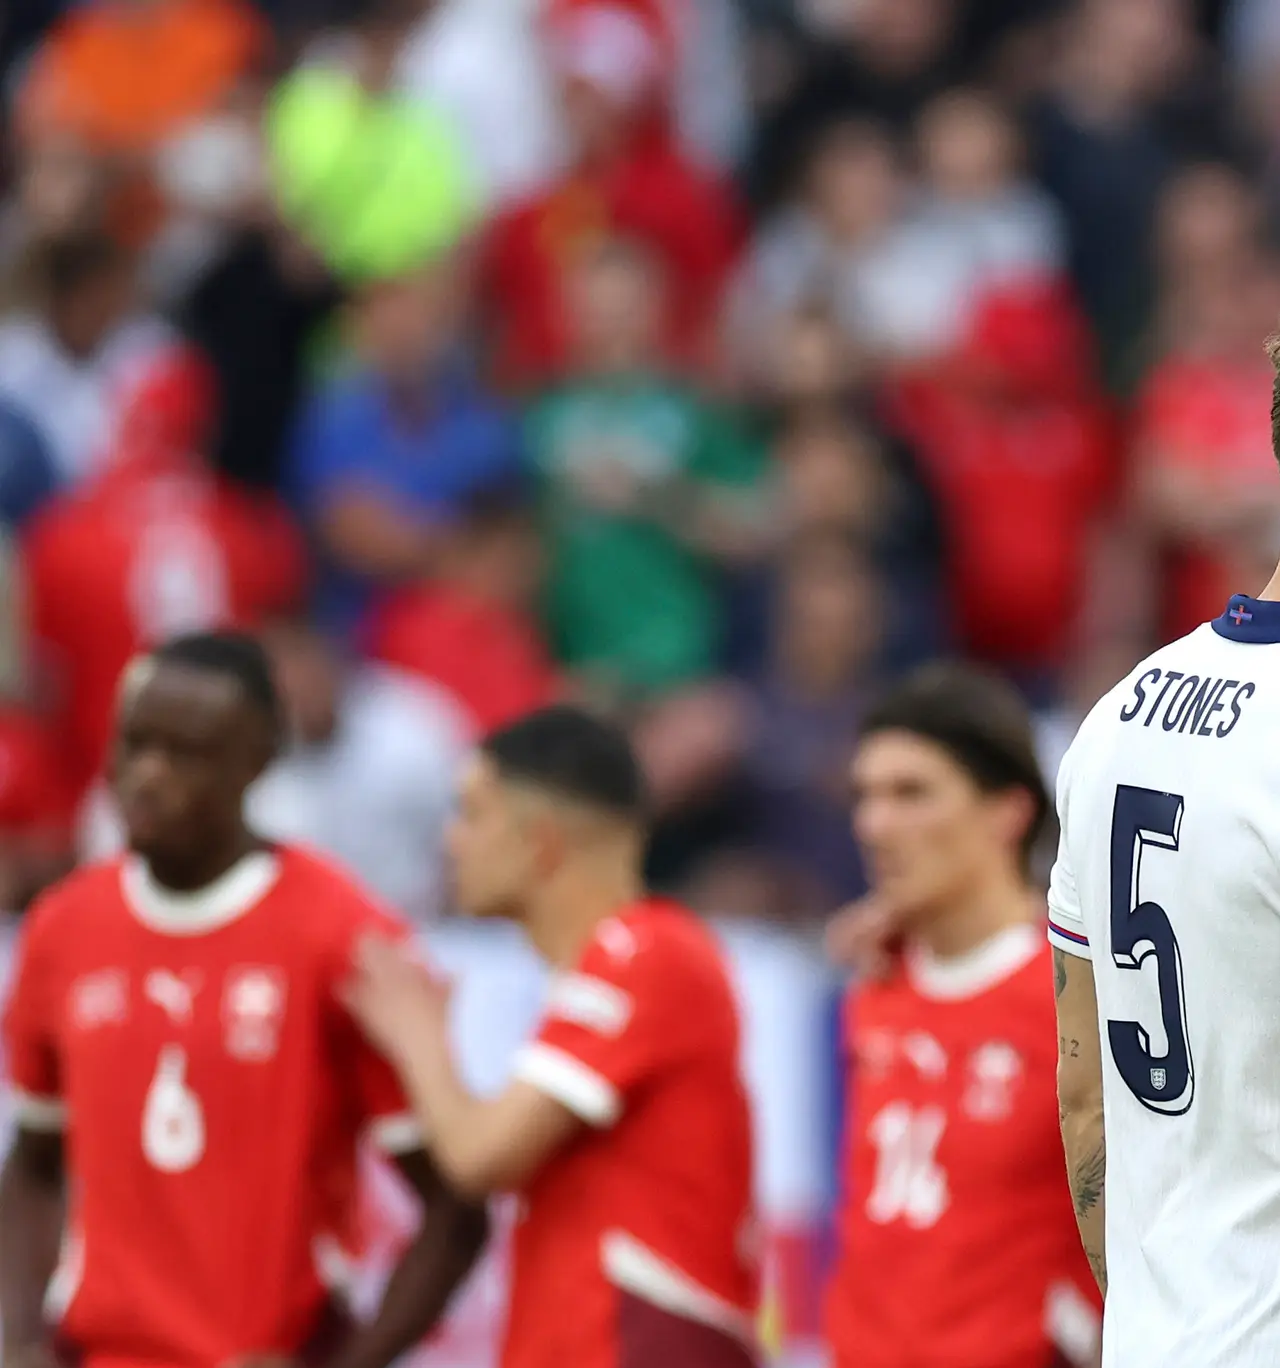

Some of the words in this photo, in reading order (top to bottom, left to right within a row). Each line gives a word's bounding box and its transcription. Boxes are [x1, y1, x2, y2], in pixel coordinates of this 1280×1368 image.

[1119, 667, 1256, 738] STONES
[1107, 784, 1194, 1116] 5
[141, 1041, 206, 1173] 6
